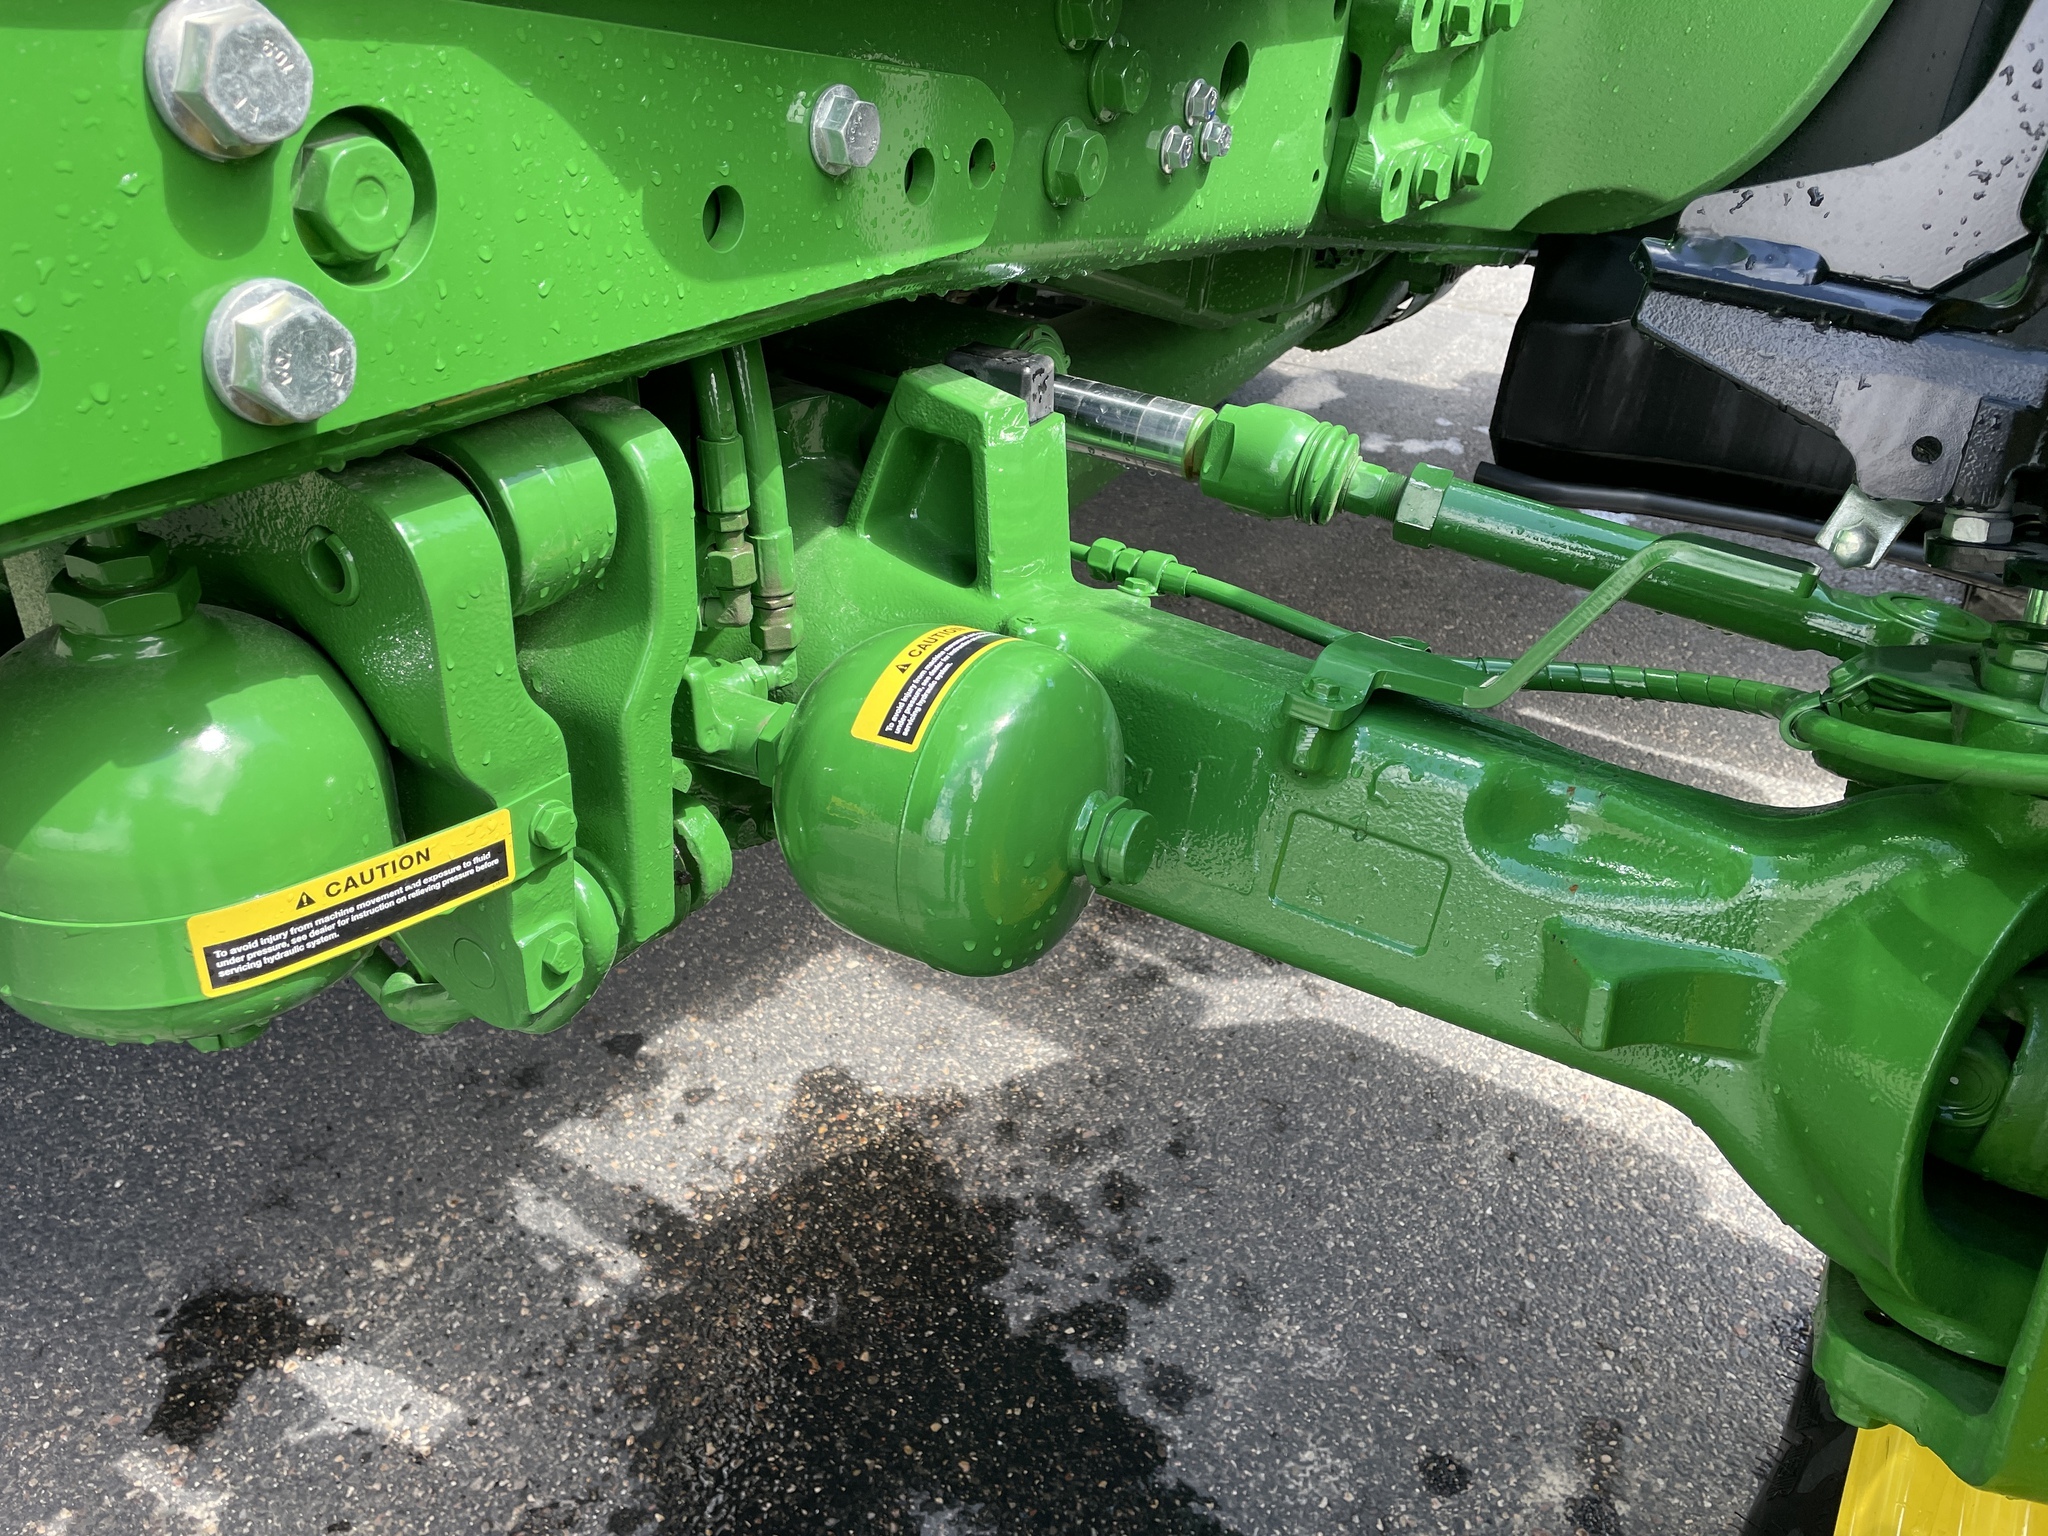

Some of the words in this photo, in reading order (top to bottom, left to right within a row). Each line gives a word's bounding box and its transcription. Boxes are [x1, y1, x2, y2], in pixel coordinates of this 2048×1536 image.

[885, 722, 895, 731] To
[891, 701, 905, 722] avoid
[901, 683, 917, 702] injury
[912, 669, 927, 684] from
[894, 714, 907, 734] under
[902, 706, 922, 737] servicing
[916, 680, 937, 707] hydraulic
[325, 847, 431, 898] CAUTION
[213, 950, 228, 959] To
[230, 939, 259, 955] avoid
[260, 930, 288, 948] injury
[289, 921, 314, 936] from
[315, 906, 355, 925] machine
[356, 886, 403, 911] movement
[405, 881, 422, 892] and
[422, 865, 461, 885] exposure
[472, 852, 491, 864] fluid
[216, 955, 246, 968] under
[246, 942, 290, 961] pressure,
[291, 935, 308, 945] see
[308, 924, 336, 938] dealer
[337, 916, 350, 927] for
[351, 901, 395, 922] instruction
[395, 896, 407, 904] on
[408, 882, 441, 900] relieving
[442, 868, 475, 887] pressure
[475, 858, 499, 873] before
[218, 960, 263, 978] servicing
[263, 945, 305, 965] hydraulic
[305, 933, 340, 949] system.
